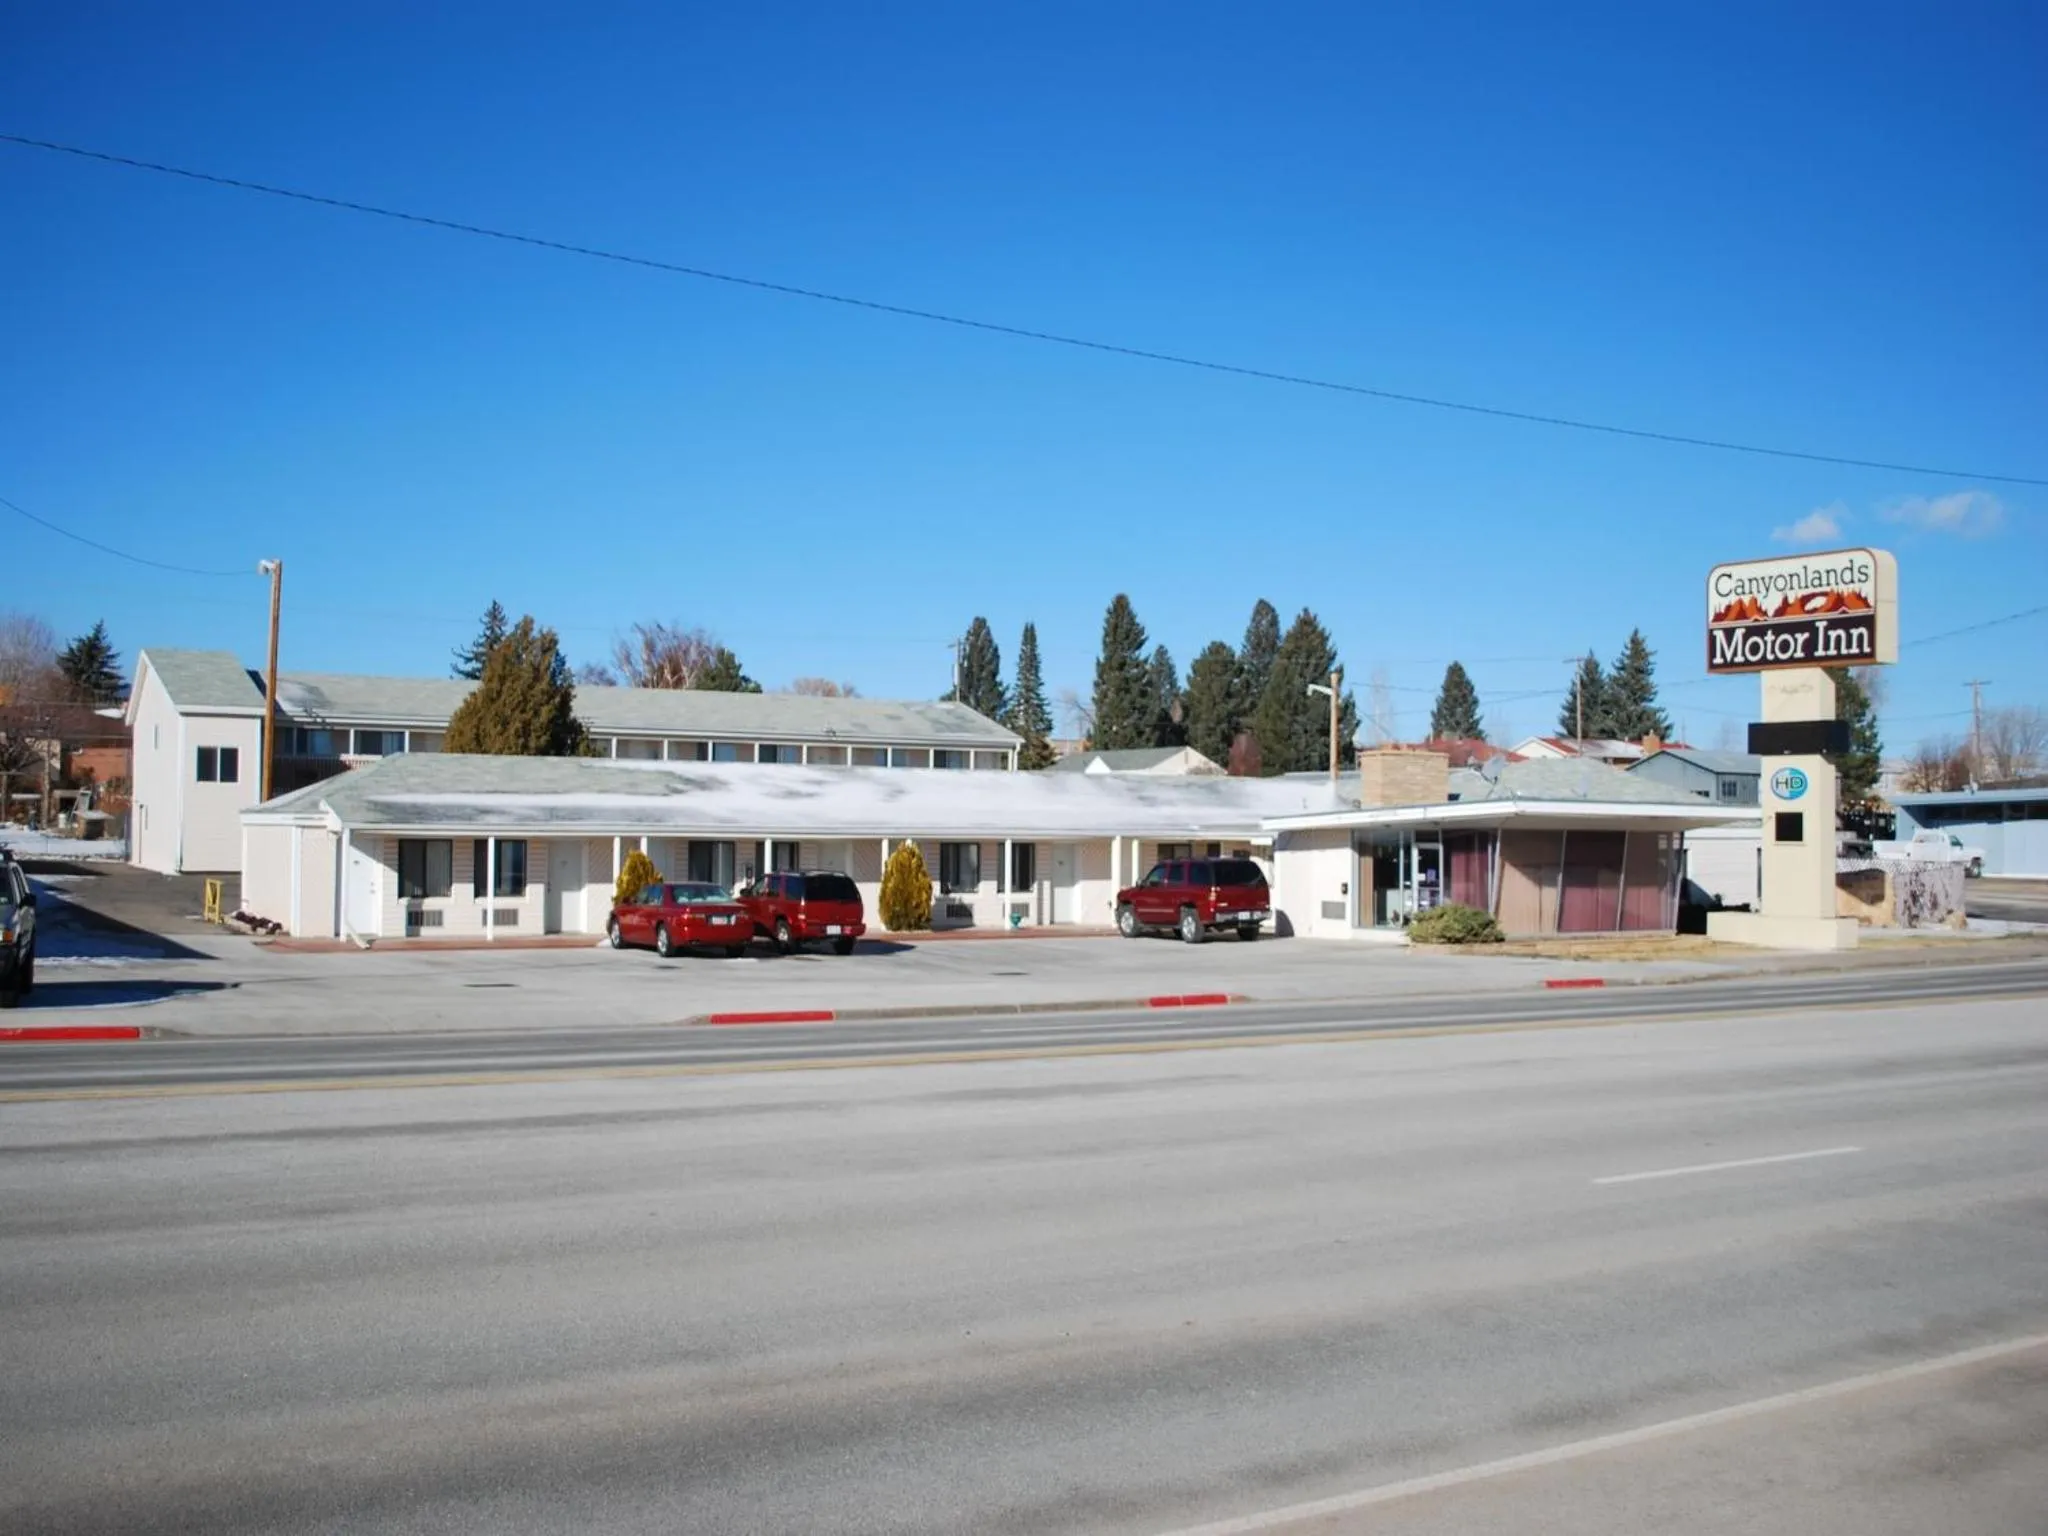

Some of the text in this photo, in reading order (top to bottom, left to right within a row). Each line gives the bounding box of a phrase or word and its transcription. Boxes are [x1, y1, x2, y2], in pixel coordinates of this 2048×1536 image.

[1715, 559, 1869, 599] Canyonlands
[1713, 621, 1871, 664] Motor Inn
